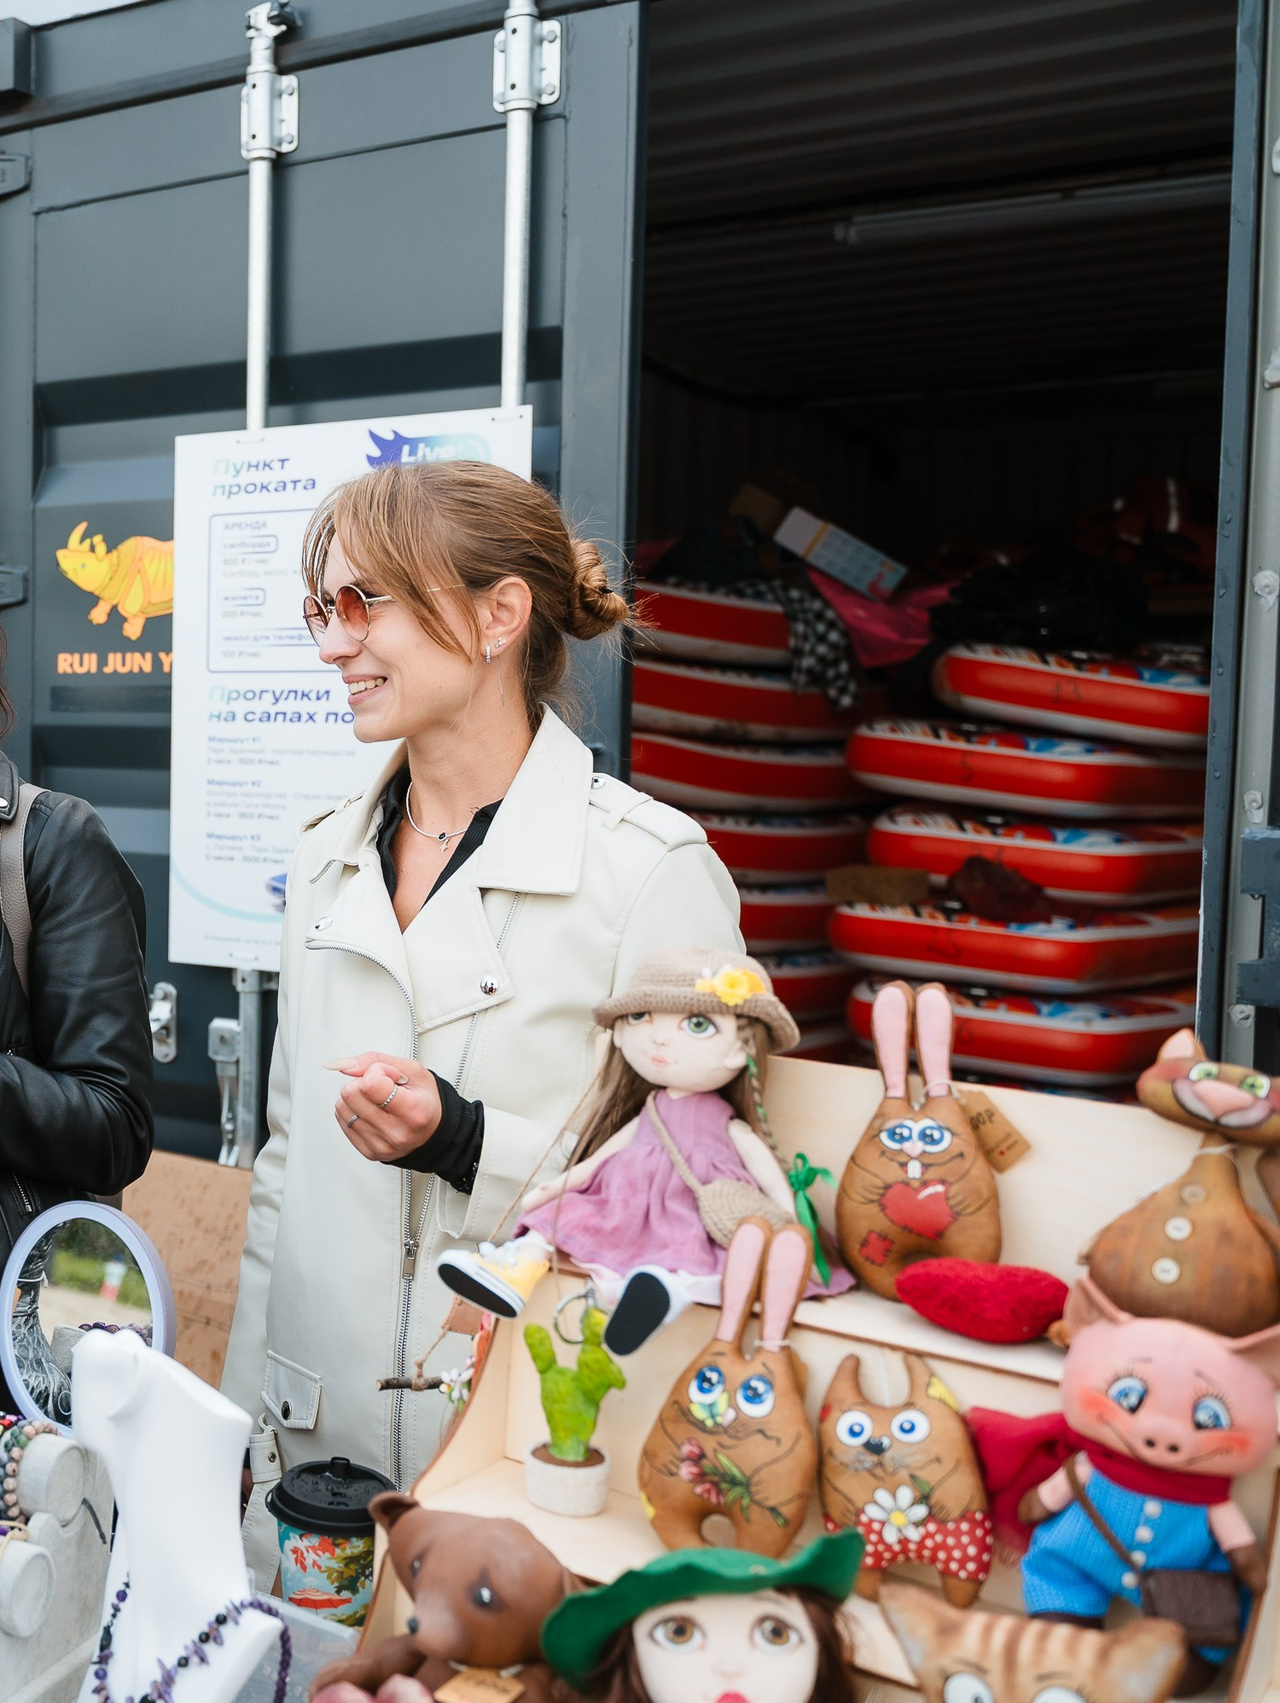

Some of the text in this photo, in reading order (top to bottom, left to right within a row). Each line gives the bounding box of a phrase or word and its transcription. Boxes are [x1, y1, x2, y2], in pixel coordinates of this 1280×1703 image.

[214, 458, 289, 477] Пункт
[213, 478, 316, 499] проката
[224, 521, 268, 530] АРЕНДА
[57, 652, 98, 674] RUI
[102, 651, 153, 674] JUN
[209, 685, 331, 705] Прогулки
[208, 711, 355, 723] на сапах по
